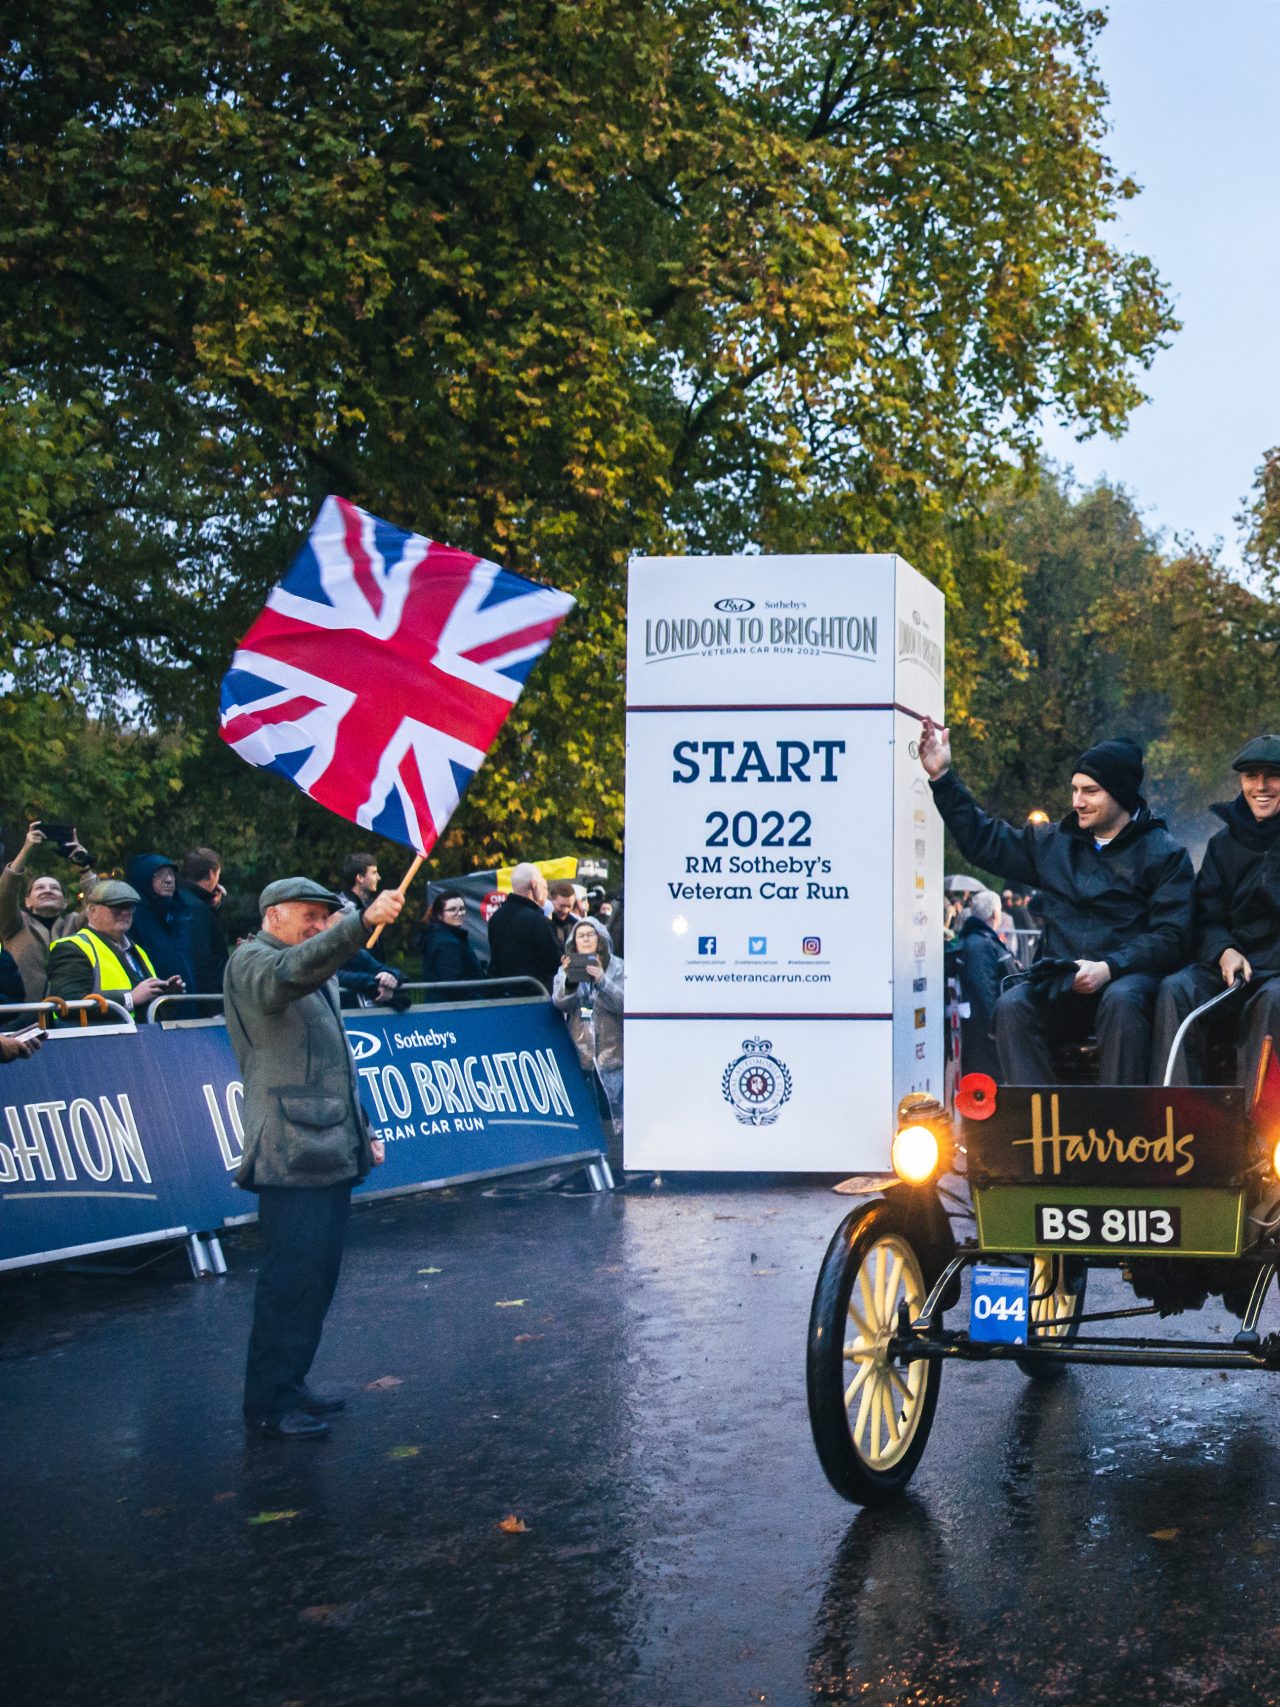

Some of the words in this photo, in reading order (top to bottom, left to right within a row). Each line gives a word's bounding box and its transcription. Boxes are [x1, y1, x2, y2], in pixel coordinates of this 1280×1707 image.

[764, 600, 807, 610] Sotheby's
[645, 617, 731, 658] LONDON
[736, 617, 764, 645] TO
[770, 616, 878, 655] BRIGHTON
[700, 646, 747, 657] VETERAN
[749, 646, 770, 654] CAR
[773, 646, 794, 654] RUN
[797, 648, 821, 656] 2022
[672, 740, 846, 784] START
[705, 810, 812, 847] 2022
[685, 856, 723, 874] RM
[729, 856, 832, 878] Sotheby's
[668, 882, 752, 900] Veteran
[759, 882, 800, 900] Car
[806, 882, 850, 900] Run
[684, 973, 831, 983] www.veterancarrun.com
[394, 1029, 457, 1049] Sotheby's
[359, 1065, 412, 1122] TO
[411, 1048, 575, 1117] BRIGHTON
[421, 1119, 450, 1136] CAR
[455, 1117, 485, 1132] RUN
[1012, 1093, 1195, 1176] Harrods
[1042, 1207, 1091, 1241] BS
[1101, 1209, 1174, 1243] 8113
[974, 1294, 1027, 1322] 044
